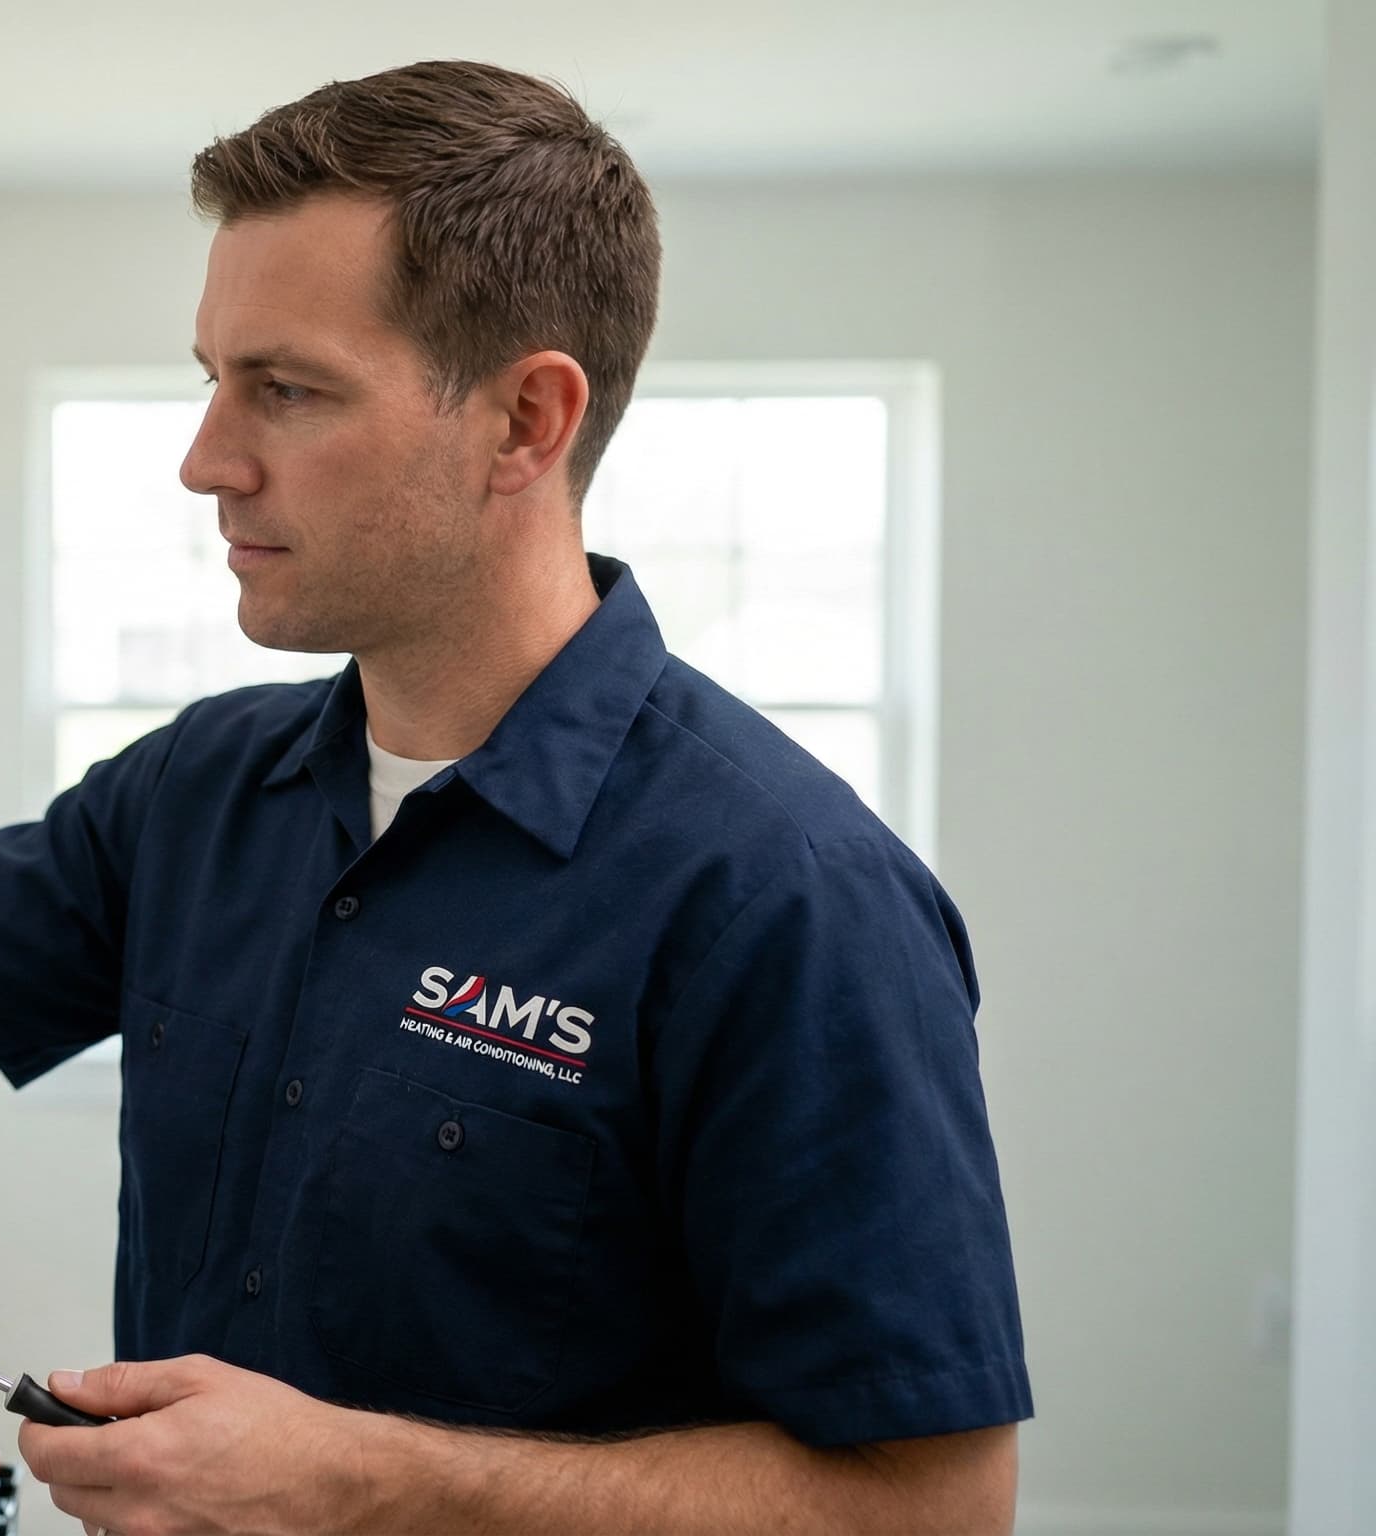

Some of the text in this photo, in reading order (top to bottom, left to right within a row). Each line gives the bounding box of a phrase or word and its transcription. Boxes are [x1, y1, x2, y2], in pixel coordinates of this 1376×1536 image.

[412, 966, 595, 1054] SAM'S
[400, 1017, 444, 1040] HEATING
[453, 1035, 473, 1050] AIR
[473, 1040, 556, 1080] CONDITIONING,
[557, 1067, 583, 1084] LLC
